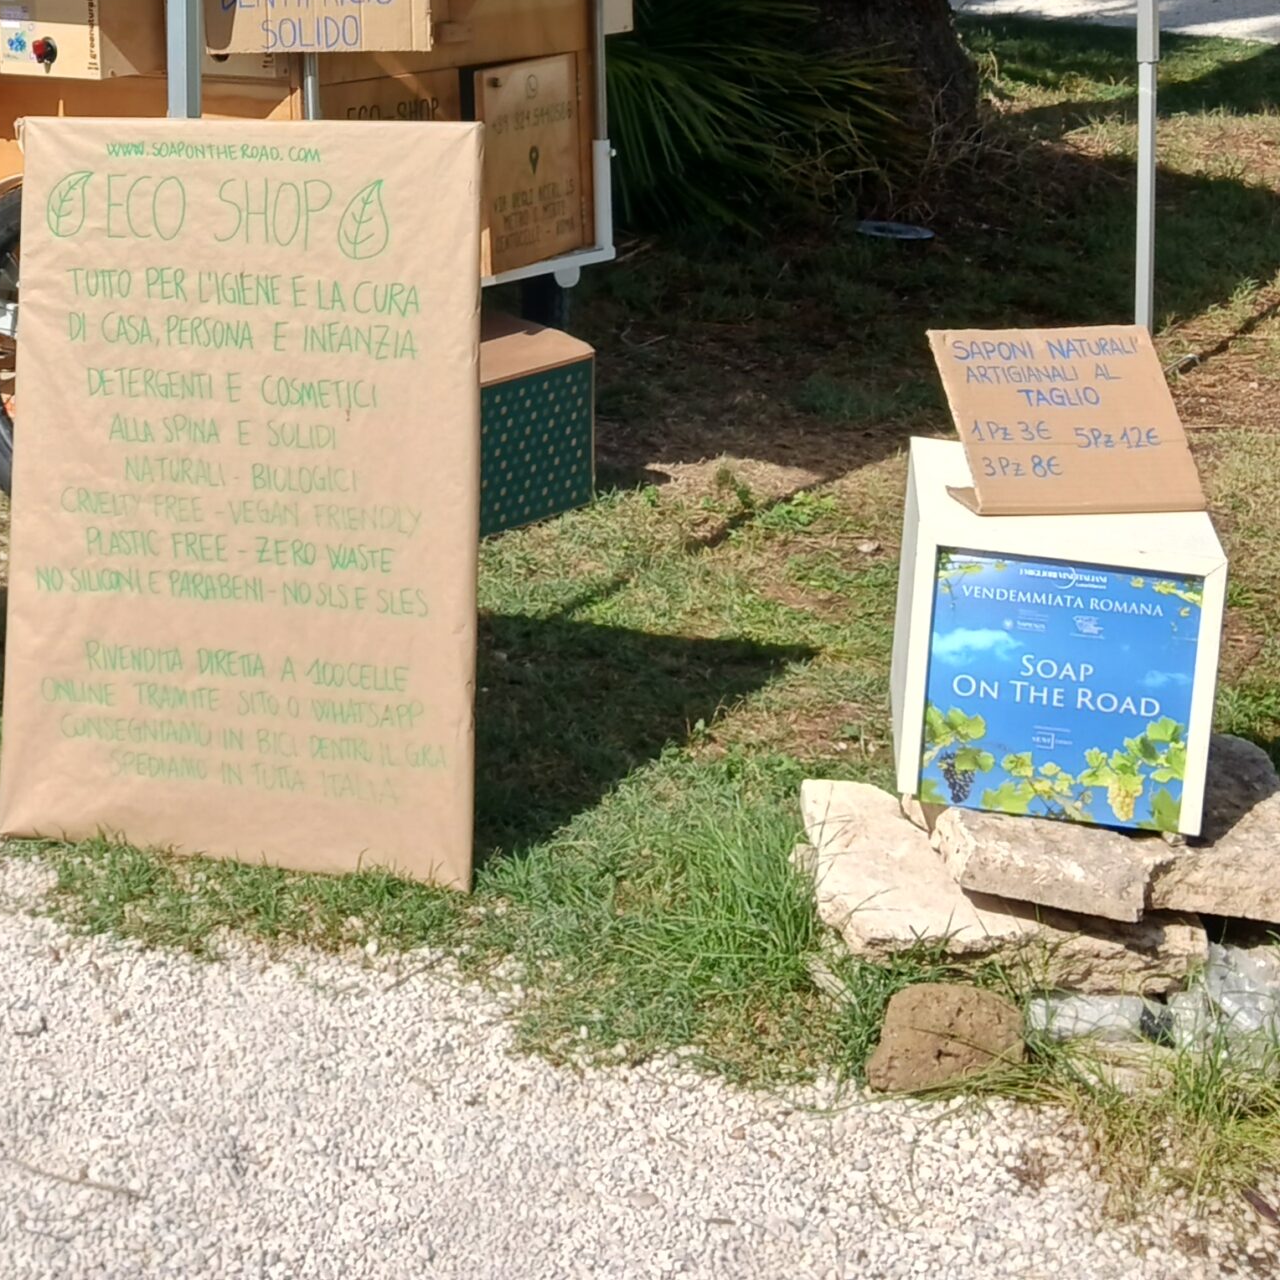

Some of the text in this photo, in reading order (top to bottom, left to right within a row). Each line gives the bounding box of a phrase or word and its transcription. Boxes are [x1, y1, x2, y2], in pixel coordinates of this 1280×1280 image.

[261, 15, 362, 50] SOLIDO
[107, 174, 332, 251] ECO SHOP
[66, 267, 421, 318] TUTTO PER L'IGIENE E LA CURA
[69, 312, 419, 360] DI CASA, PERSONA E INFANZIA
[952, 339, 1034, 361] SAPONI
[87, 367, 378, 409] DETERGENTI E COSMETICI
[966, 363, 1122, 384] ARTIGIANALI AL
[1017, 386, 1100, 407] TAGLIO
[109, 414, 337, 450] ALLA SPINA E SOLIDI
[1018, 421, 1053, 441] 3€
[1120, 426, 1163, 449] 12€
[124, 455, 227, 488] NATURALI
[251, 462, 358, 494] BIOLOGICI
[1031, 454, 1063, 478] 8€
[60, 486, 142, 517] CRUELTY
[154, 494, 205, 524] FREE
[228, 500, 300, 529] VEGAN
[313, 504, 423, 537] FRIENDLY
[86, 527, 160, 557] PLASTIC
[171, 531, 228, 562] FREE
[256, 536, 317, 567] ZERO
[325, 543, 395, 573] WASTE
[36, 567, 64, 593] NO
[70, 567, 142, 593] SILICONI
[148, 570, 161, 595] E
[168, 569, 264, 603] PARABENI
[282, 581, 311, 606] NO
[316, 583, 349, 609] SLS
[355, 588, 369, 611] E
[376, 588, 430, 618] SLES
[961, 584, 1164, 617] VENDEMMIATA ROMANA
[85, 639, 410, 693] RIVENDITA DIRETTA A 100CELLE
[1020, 654, 1094, 682] SOAP
[41, 676, 424, 729] ONLINE TRAMITE SITO O WHATSAPP
[952, 674, 1161, 718] ON THE ROAD
[60, 713, 212, 747] CONSEGNIAMO
[222, 728, 245, 752] IN
[380, 742, 400, 768] IL
[108, 749, 208, 780] SPEDIAMO
[222, 762, 244, 786] IN
[251, 762, 305, 792] TUTTA
